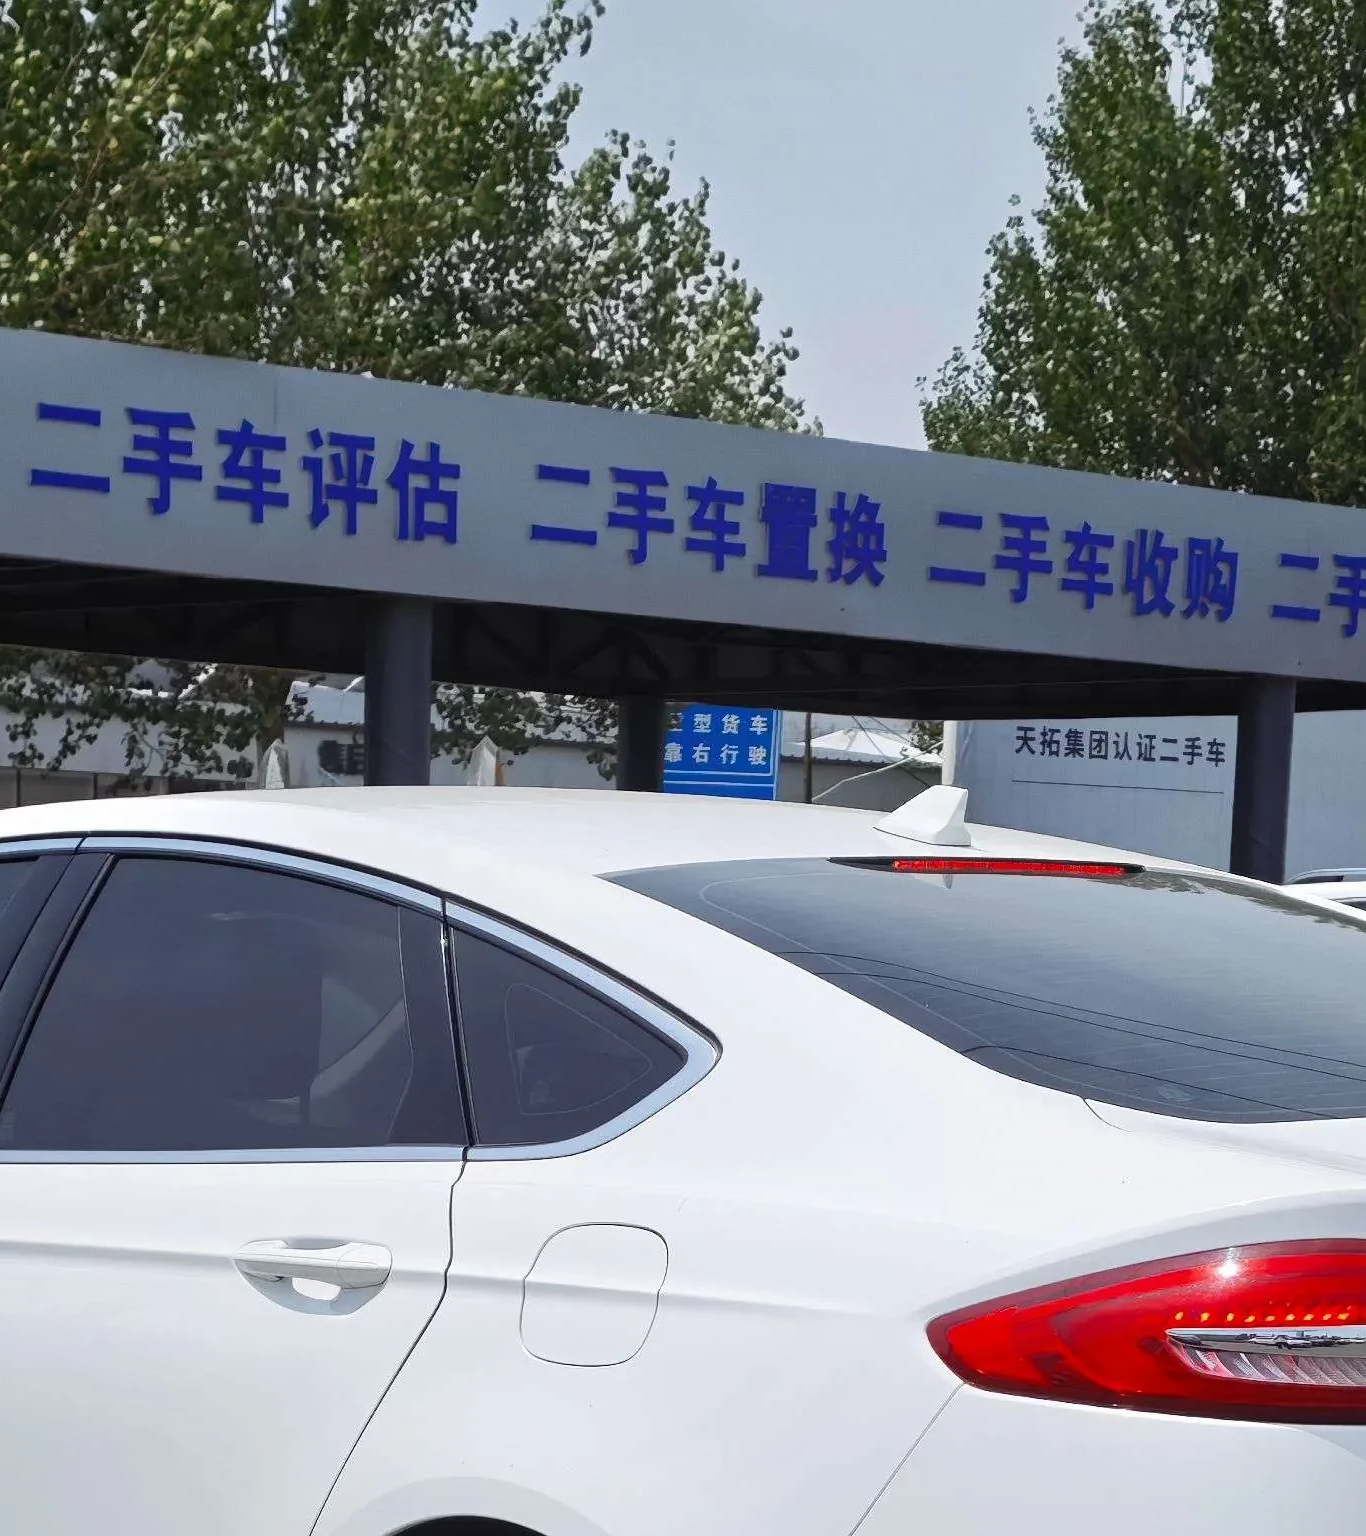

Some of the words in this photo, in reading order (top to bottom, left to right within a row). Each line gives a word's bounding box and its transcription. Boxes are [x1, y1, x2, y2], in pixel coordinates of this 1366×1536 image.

[31, 402, 461, 543] 二手车评估
[530, 463, 888, 586] 二手车置换
[928, 510, 1239, 620] 二手车收购
[663, 741, 767, 766] 靠右行驶
[1014, 725, 1227, 768] 天拓集团认证二手车
